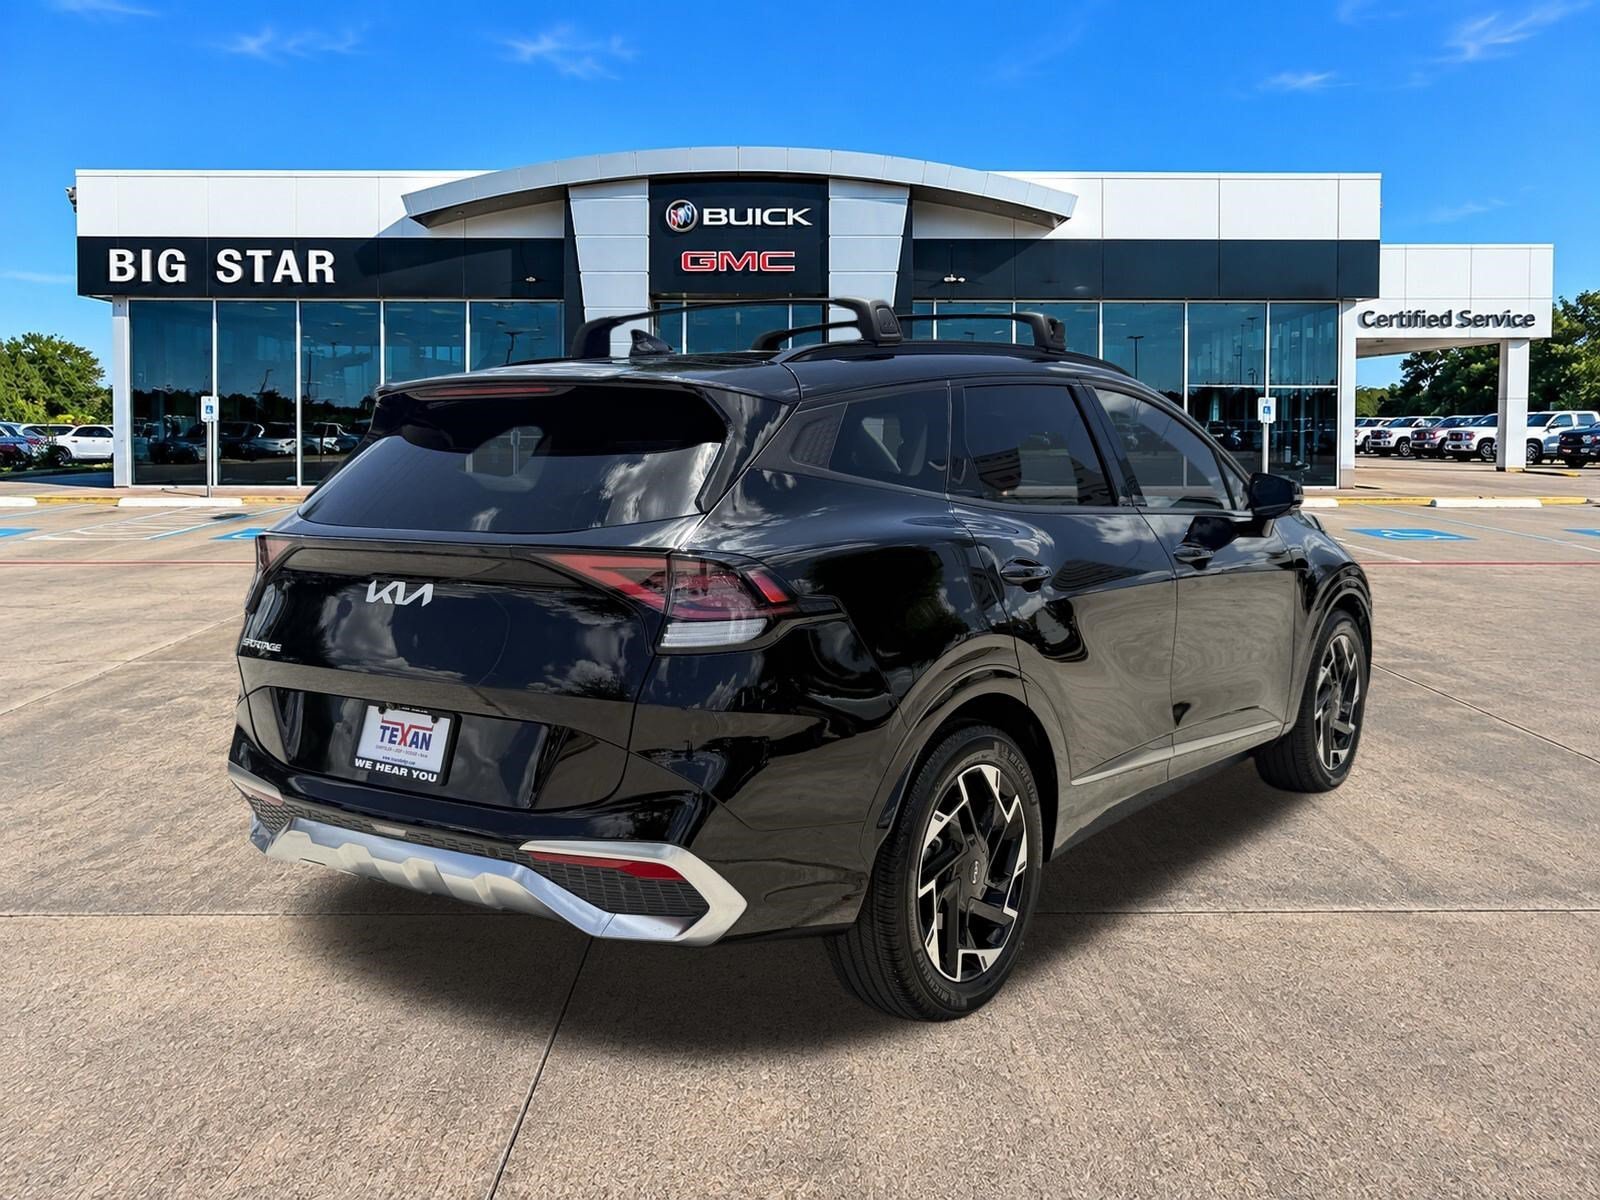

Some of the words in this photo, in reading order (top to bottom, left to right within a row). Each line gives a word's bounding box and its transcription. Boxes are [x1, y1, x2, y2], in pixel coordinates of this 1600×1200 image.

[703, 208, 813, 226] BUICK
[108, 248, 187, 284] BIG
[216, 248, 336, 284] STAR
[681, 251, 796, 272] GMC
[1359, 309, 1453, 328] Certified
[1456, 309, 1536, 328] Service
[365, 579, 434, 607] KIA
[242, 638, 282, 652] SPORTAGE
[380, 719, 433, 751] TEXAN
[354, 758, 374, 770] WE
[375, 762, 408, 777] HEAR
[411, 769, 438, 783] YOU
[1009, 752, 1037, 802] MICHELIN
